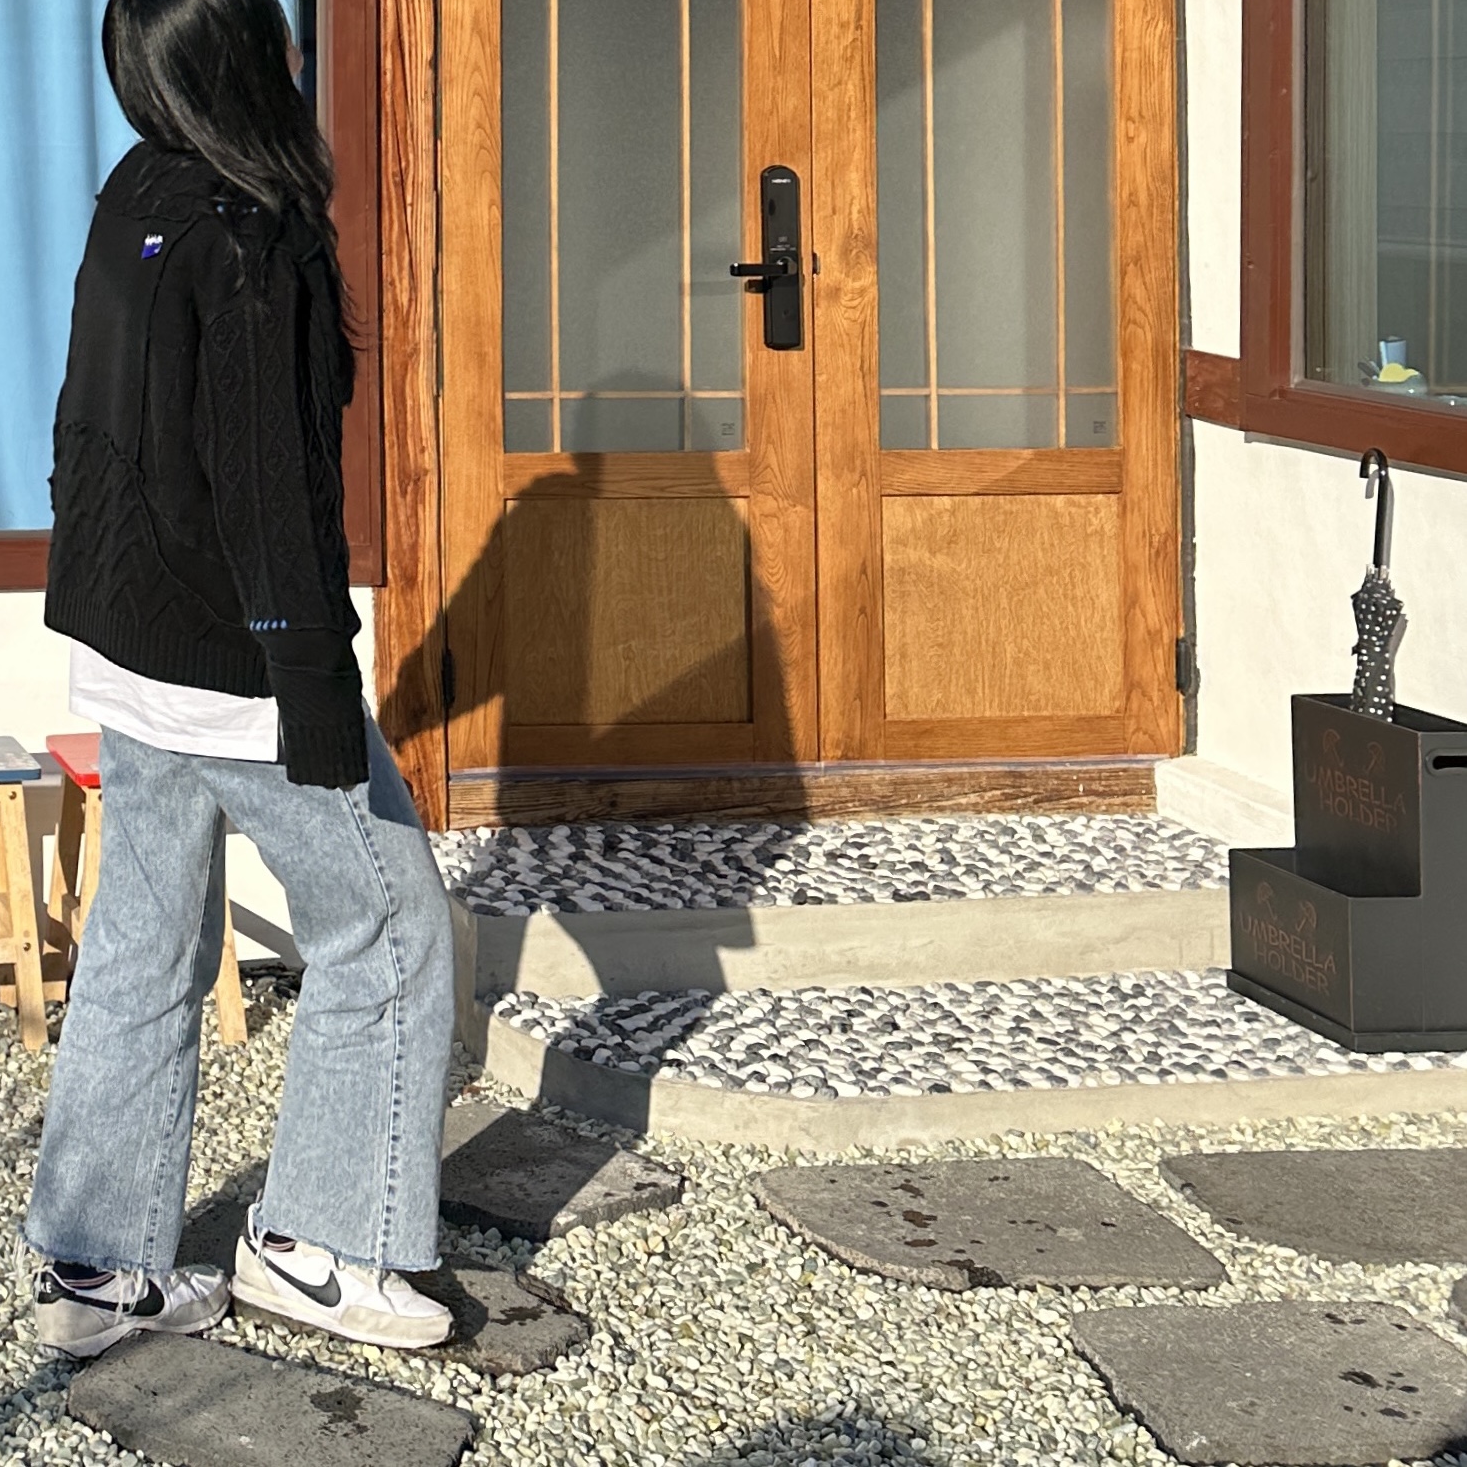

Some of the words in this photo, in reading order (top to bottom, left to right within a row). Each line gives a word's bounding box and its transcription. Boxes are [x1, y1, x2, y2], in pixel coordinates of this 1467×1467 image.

[1303, 761, 1407, 815] UMBRELLA
[1318, 789, 1398, 833] HOLDER
[1240, 911, 1336, 973] UMBRELLA
[1254, 941, 1330, 996] HOLDER
